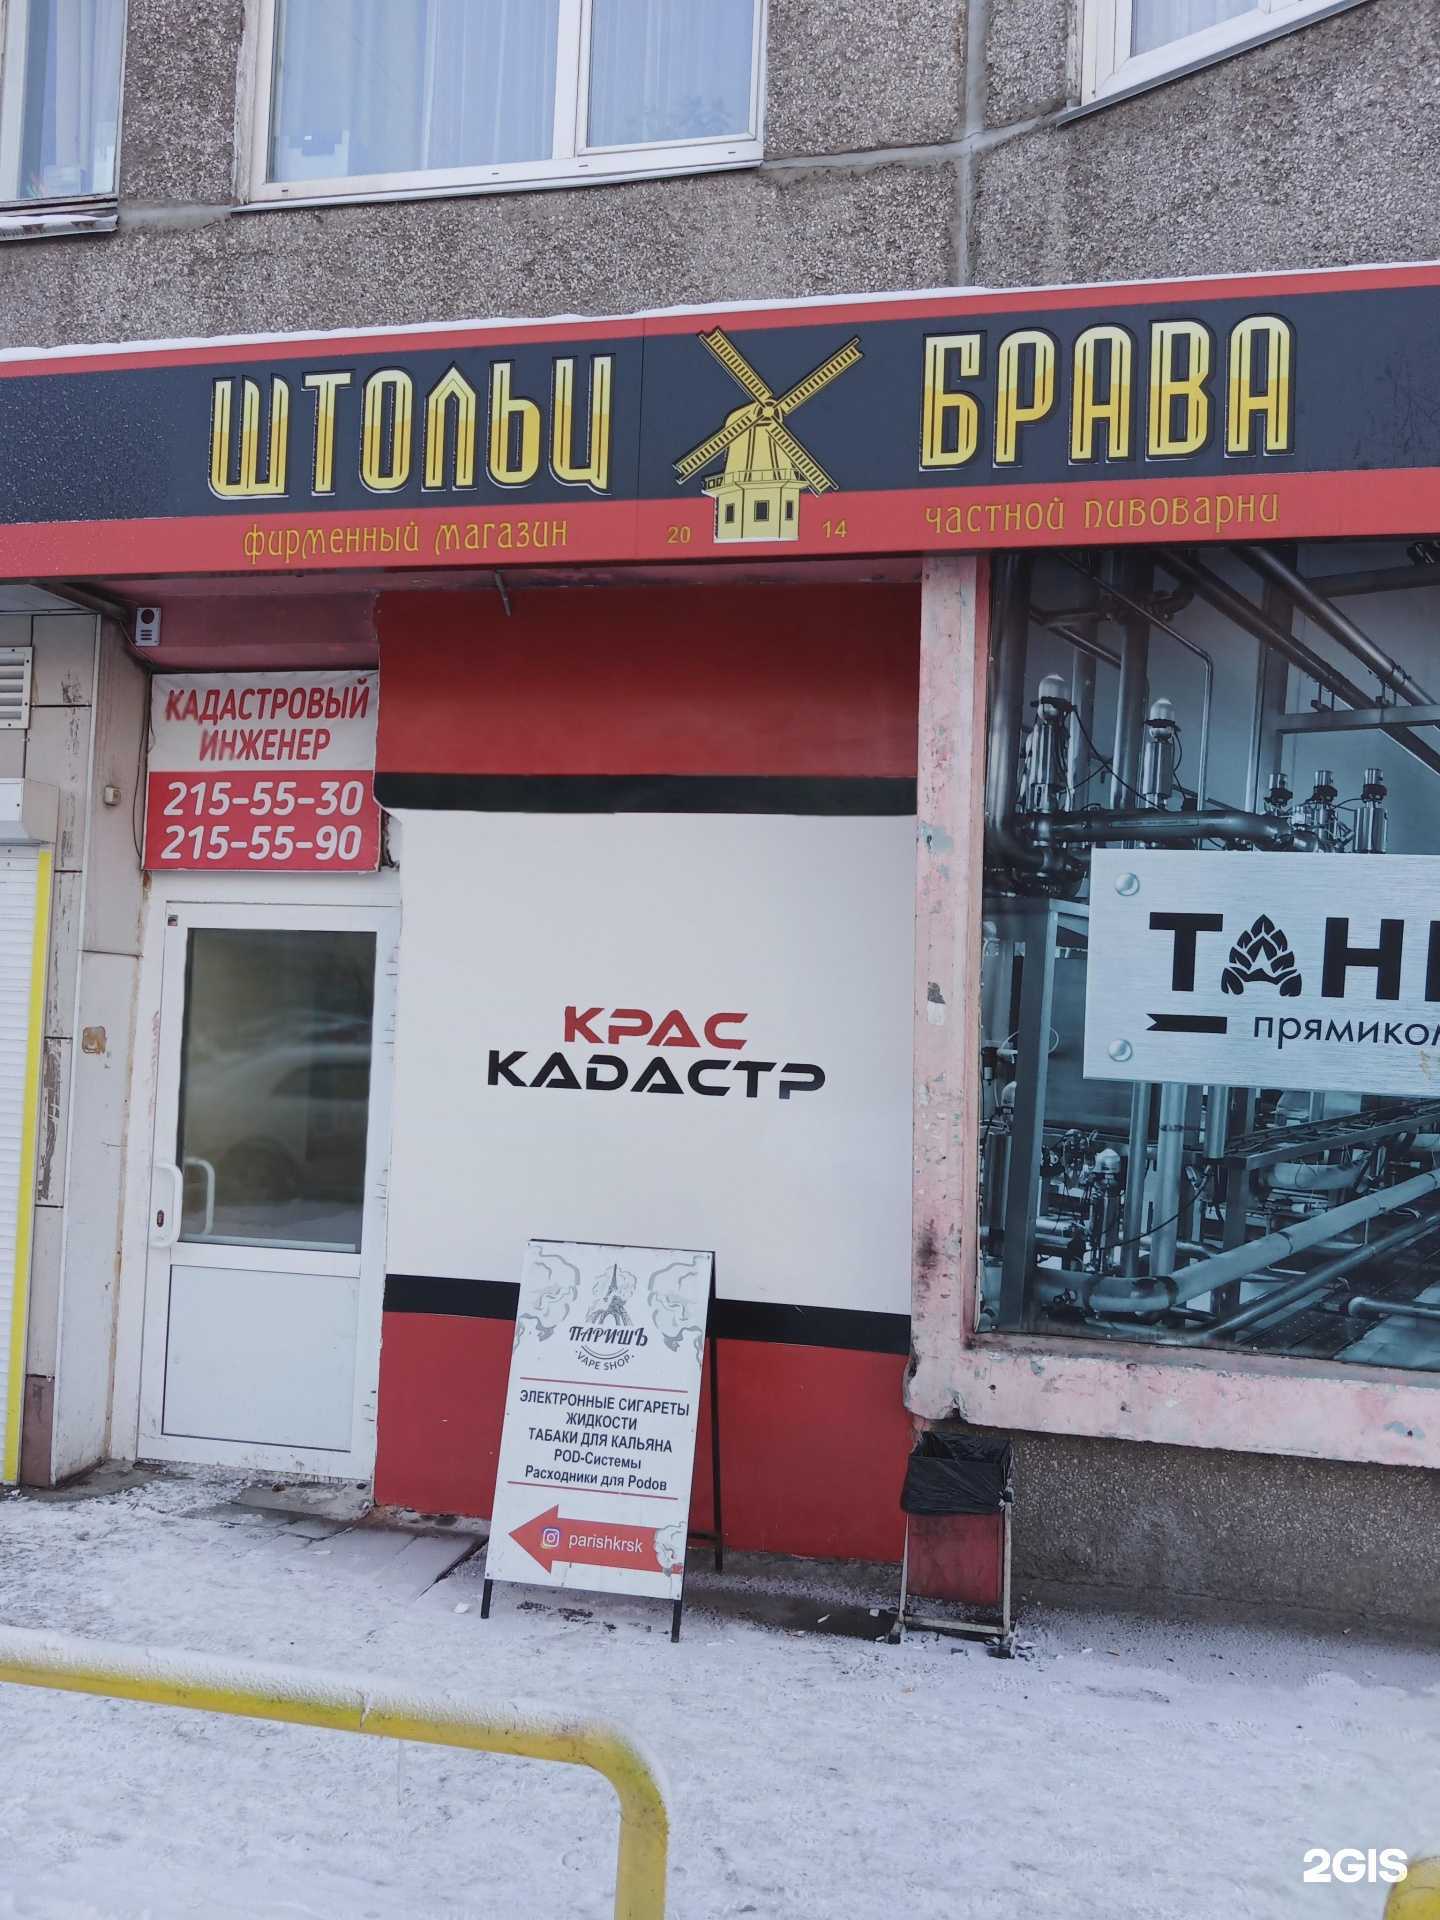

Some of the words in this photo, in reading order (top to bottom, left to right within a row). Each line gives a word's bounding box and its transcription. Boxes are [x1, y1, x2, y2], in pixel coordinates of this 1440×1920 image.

[920, 314, 1295, 471] БРАВА
[209, 354, 615, 498] ШТОЛЬЦ
[822, 520, 847, 538] 14
[925, 496, 1064, 535] частной
[1083, 492, 1279, 532] пивоварни
[243, 519, 419, 563] фирменный
[433, 520, 568, 552] магазин
[667, 526, 691, 544] 20
[165, 678, 370, 725] КАДАСТРОВЫЙ
[198, 728, 331, 761] ИНЖЕНЕР
[162, 780, 364, 817] 215-55-30
[160, 824, 363, 862] 215-55-90
[1149, 911, 1440, 1002] ТАН
[564, 1005, 748, 1050] КРАС
[577, 1351, 601, 1370] VAPE
[603, 1354, 631, 1371] SHOP
[519, 1389, 616, 1410] ЭЛЕКТРОННЫЕ
[618, 1397, 690, 1417] СИГАРЕТЫ
[566, 1411, 638, 1430] ЖИДКОСТИ
[528, 1427, 578, 1444] ТАБАКИ
[581, 1432, 608, 1447] ДЛЯ
[611, 1435, 673, 1453] КАЛЬЯНА
[554, 1448, 642, 1469] POD-Системы
[525, 1465, 598, 1485] Расходники
[600, 1475, 624, 1489] для
[628, 1475, 667, 1491] Podов
[568, 1532, 643, 1554] parishkrsk
